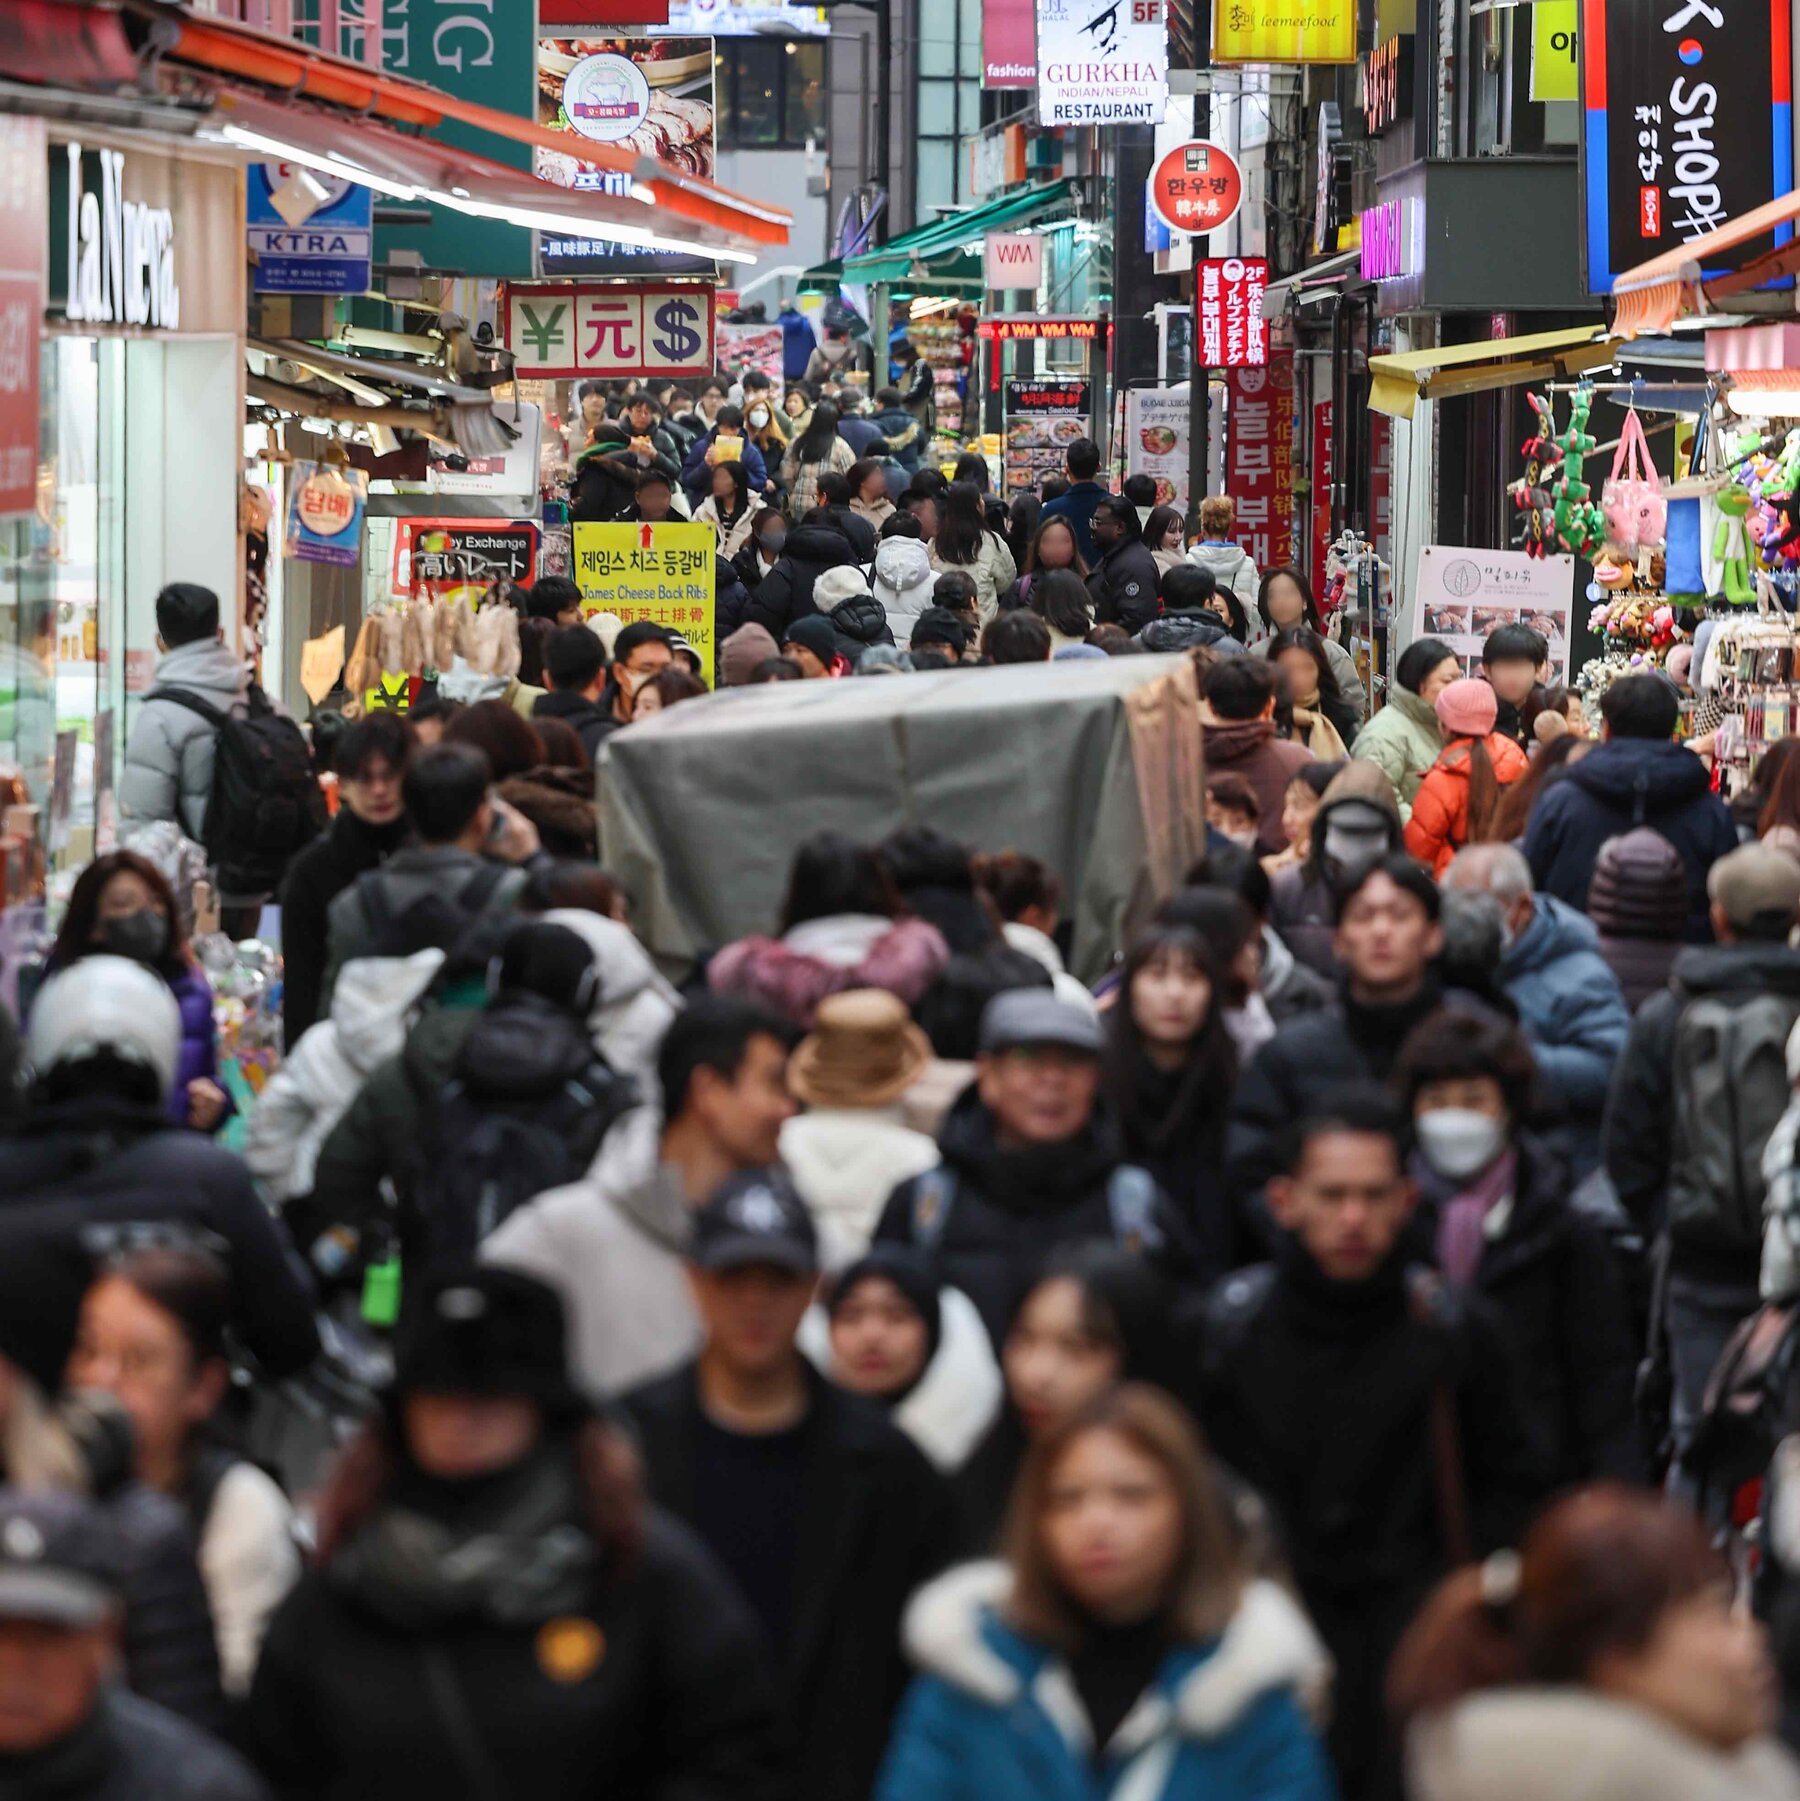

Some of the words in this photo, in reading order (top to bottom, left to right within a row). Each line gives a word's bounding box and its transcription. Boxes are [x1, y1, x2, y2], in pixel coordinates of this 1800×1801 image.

[1133, 2, 1159, 22] 5F
[1261, 14, 1339, 30] leemeefood
[987, 63, 1035, 78] fashion
[1047, 63, 1158, 83] GURKHA
[1058, 86, 1149, 98] INDIAN/NEPALI
[1054, 104, 1153, 119] RESTAURANT
[1167, 177, 1229, 196] 한우방
[267, 234, 348, 252] KTRA
[997, 244, 1033, 265] WM
[1246, 266, 1265, 281] 2F
[584, 303, 636, 360] 元
[652, 299, 701, 362] $
[1011, 323, 1037, 337] WM
[1040, 323, 1066, 337] WM
[1069, 323, 1096, 337] WM
[1048, 406, 1079, 414] Seafood
[304, 490, 349, 516] 담배
[466, 536, 527, 551] Exchange
[424, 552, 525, 578] 高いレート
[581, 551, 626, 576] 제임스
[630, 550, 660, 573] 치즈
[663, 550, 708, 576] 등갈비
[582, 584, 614, 600] James
[617, 584, 656, 600] Cheese
[658, 584, 683, 600] Back
[686, 584, 708, 600] Ribs
